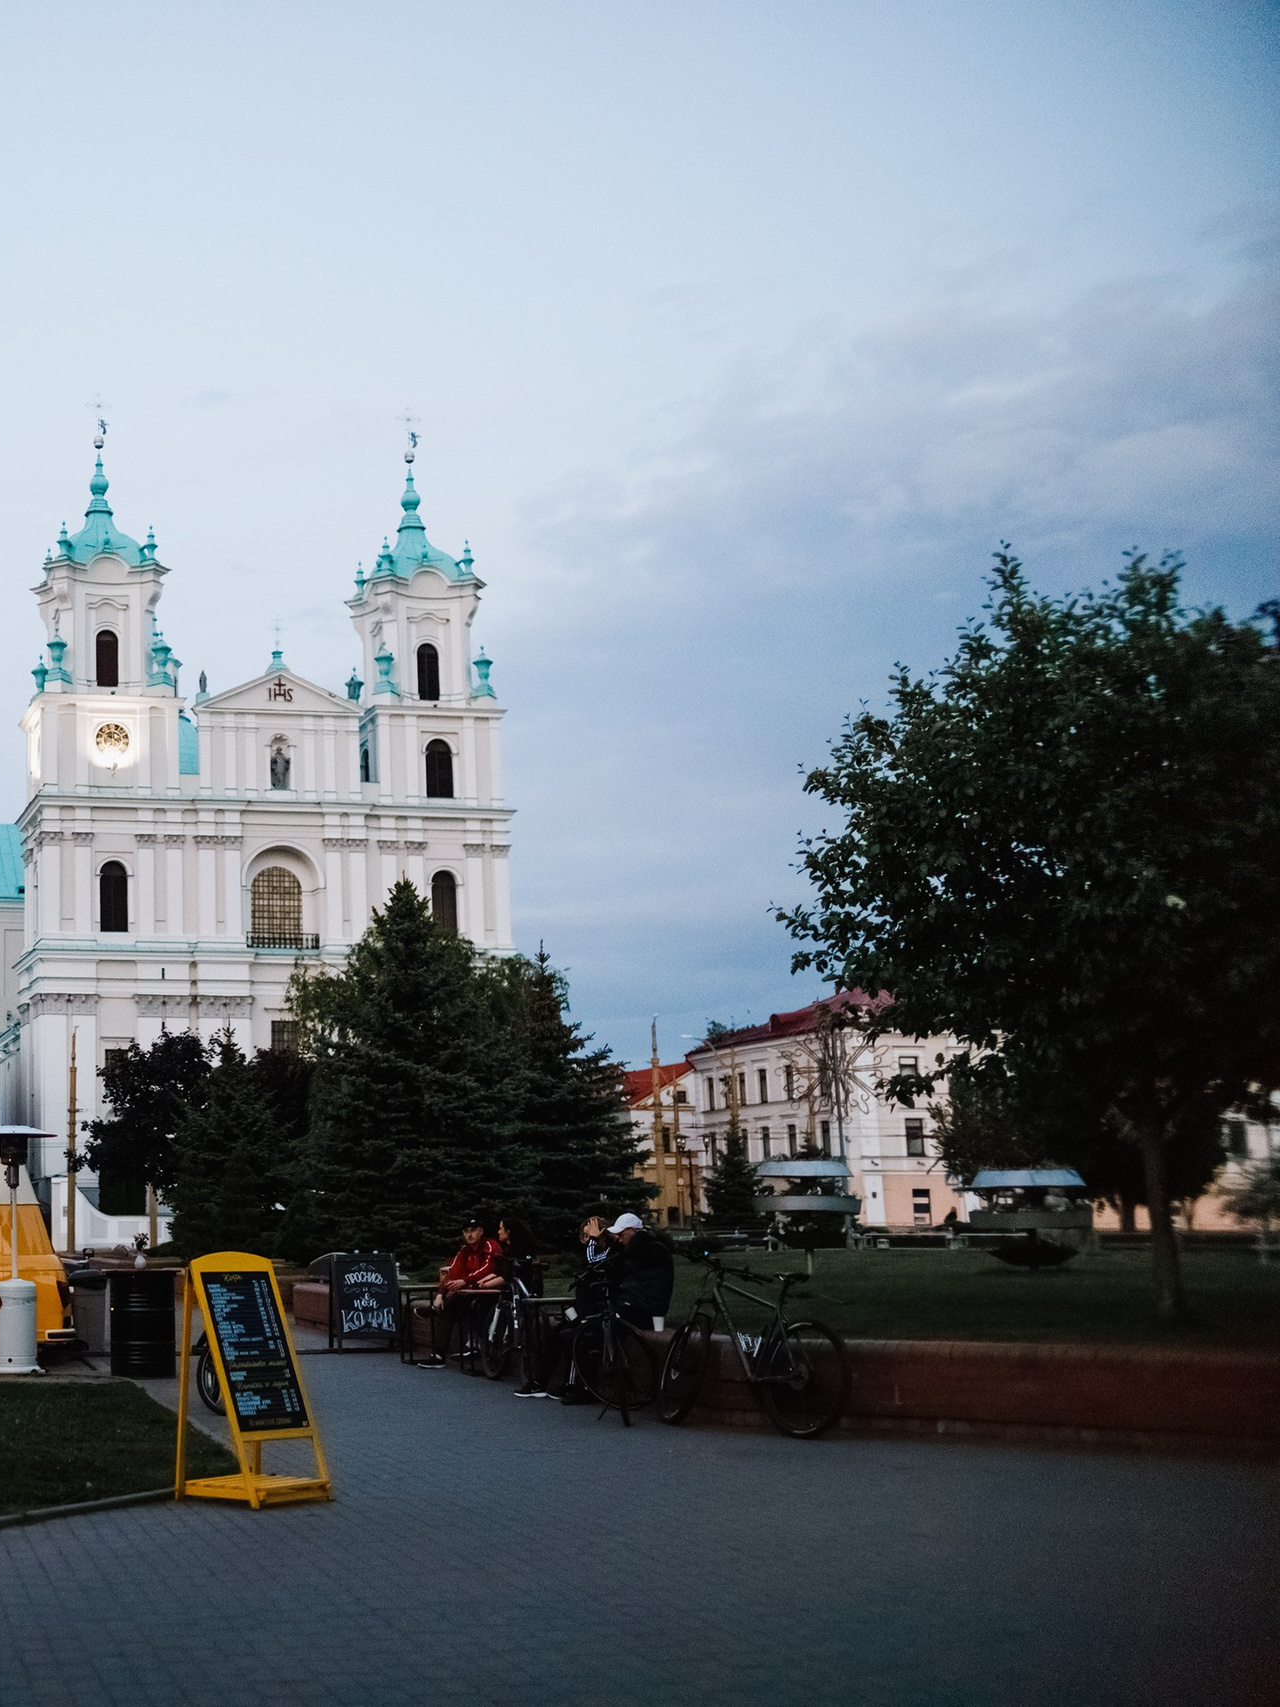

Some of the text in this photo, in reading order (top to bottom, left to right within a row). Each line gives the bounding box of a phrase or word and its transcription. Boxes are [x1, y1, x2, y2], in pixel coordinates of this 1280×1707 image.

[268, 687, 293, 702] IHS
[344, 1271, 383, 1285] ПРОСНИСЬ
[341, 1307, 396, 1333] КОФЕ
